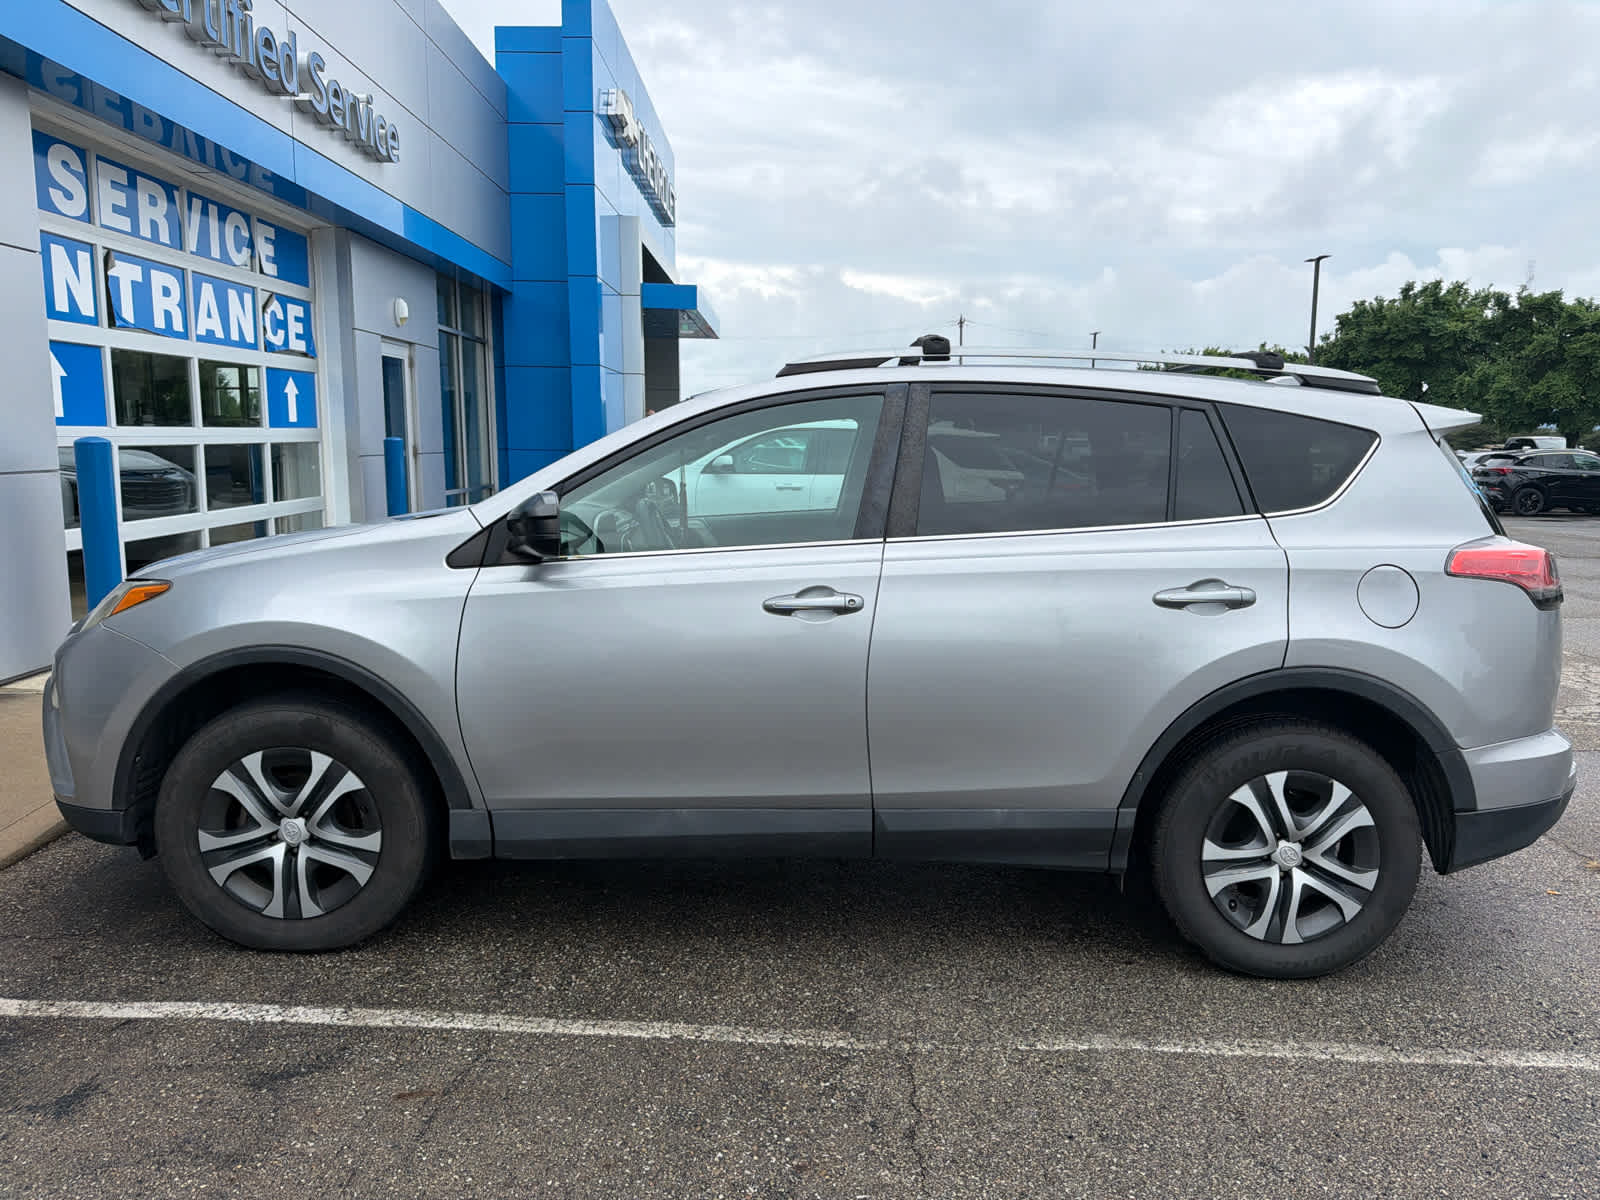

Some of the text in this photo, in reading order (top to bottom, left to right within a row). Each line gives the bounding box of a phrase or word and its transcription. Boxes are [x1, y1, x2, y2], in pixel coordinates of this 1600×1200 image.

[308, 51, 400, 163] Service
[47, 143, 279, 277] SERVICE
[50, 243, 307, 353] NTRANCE
